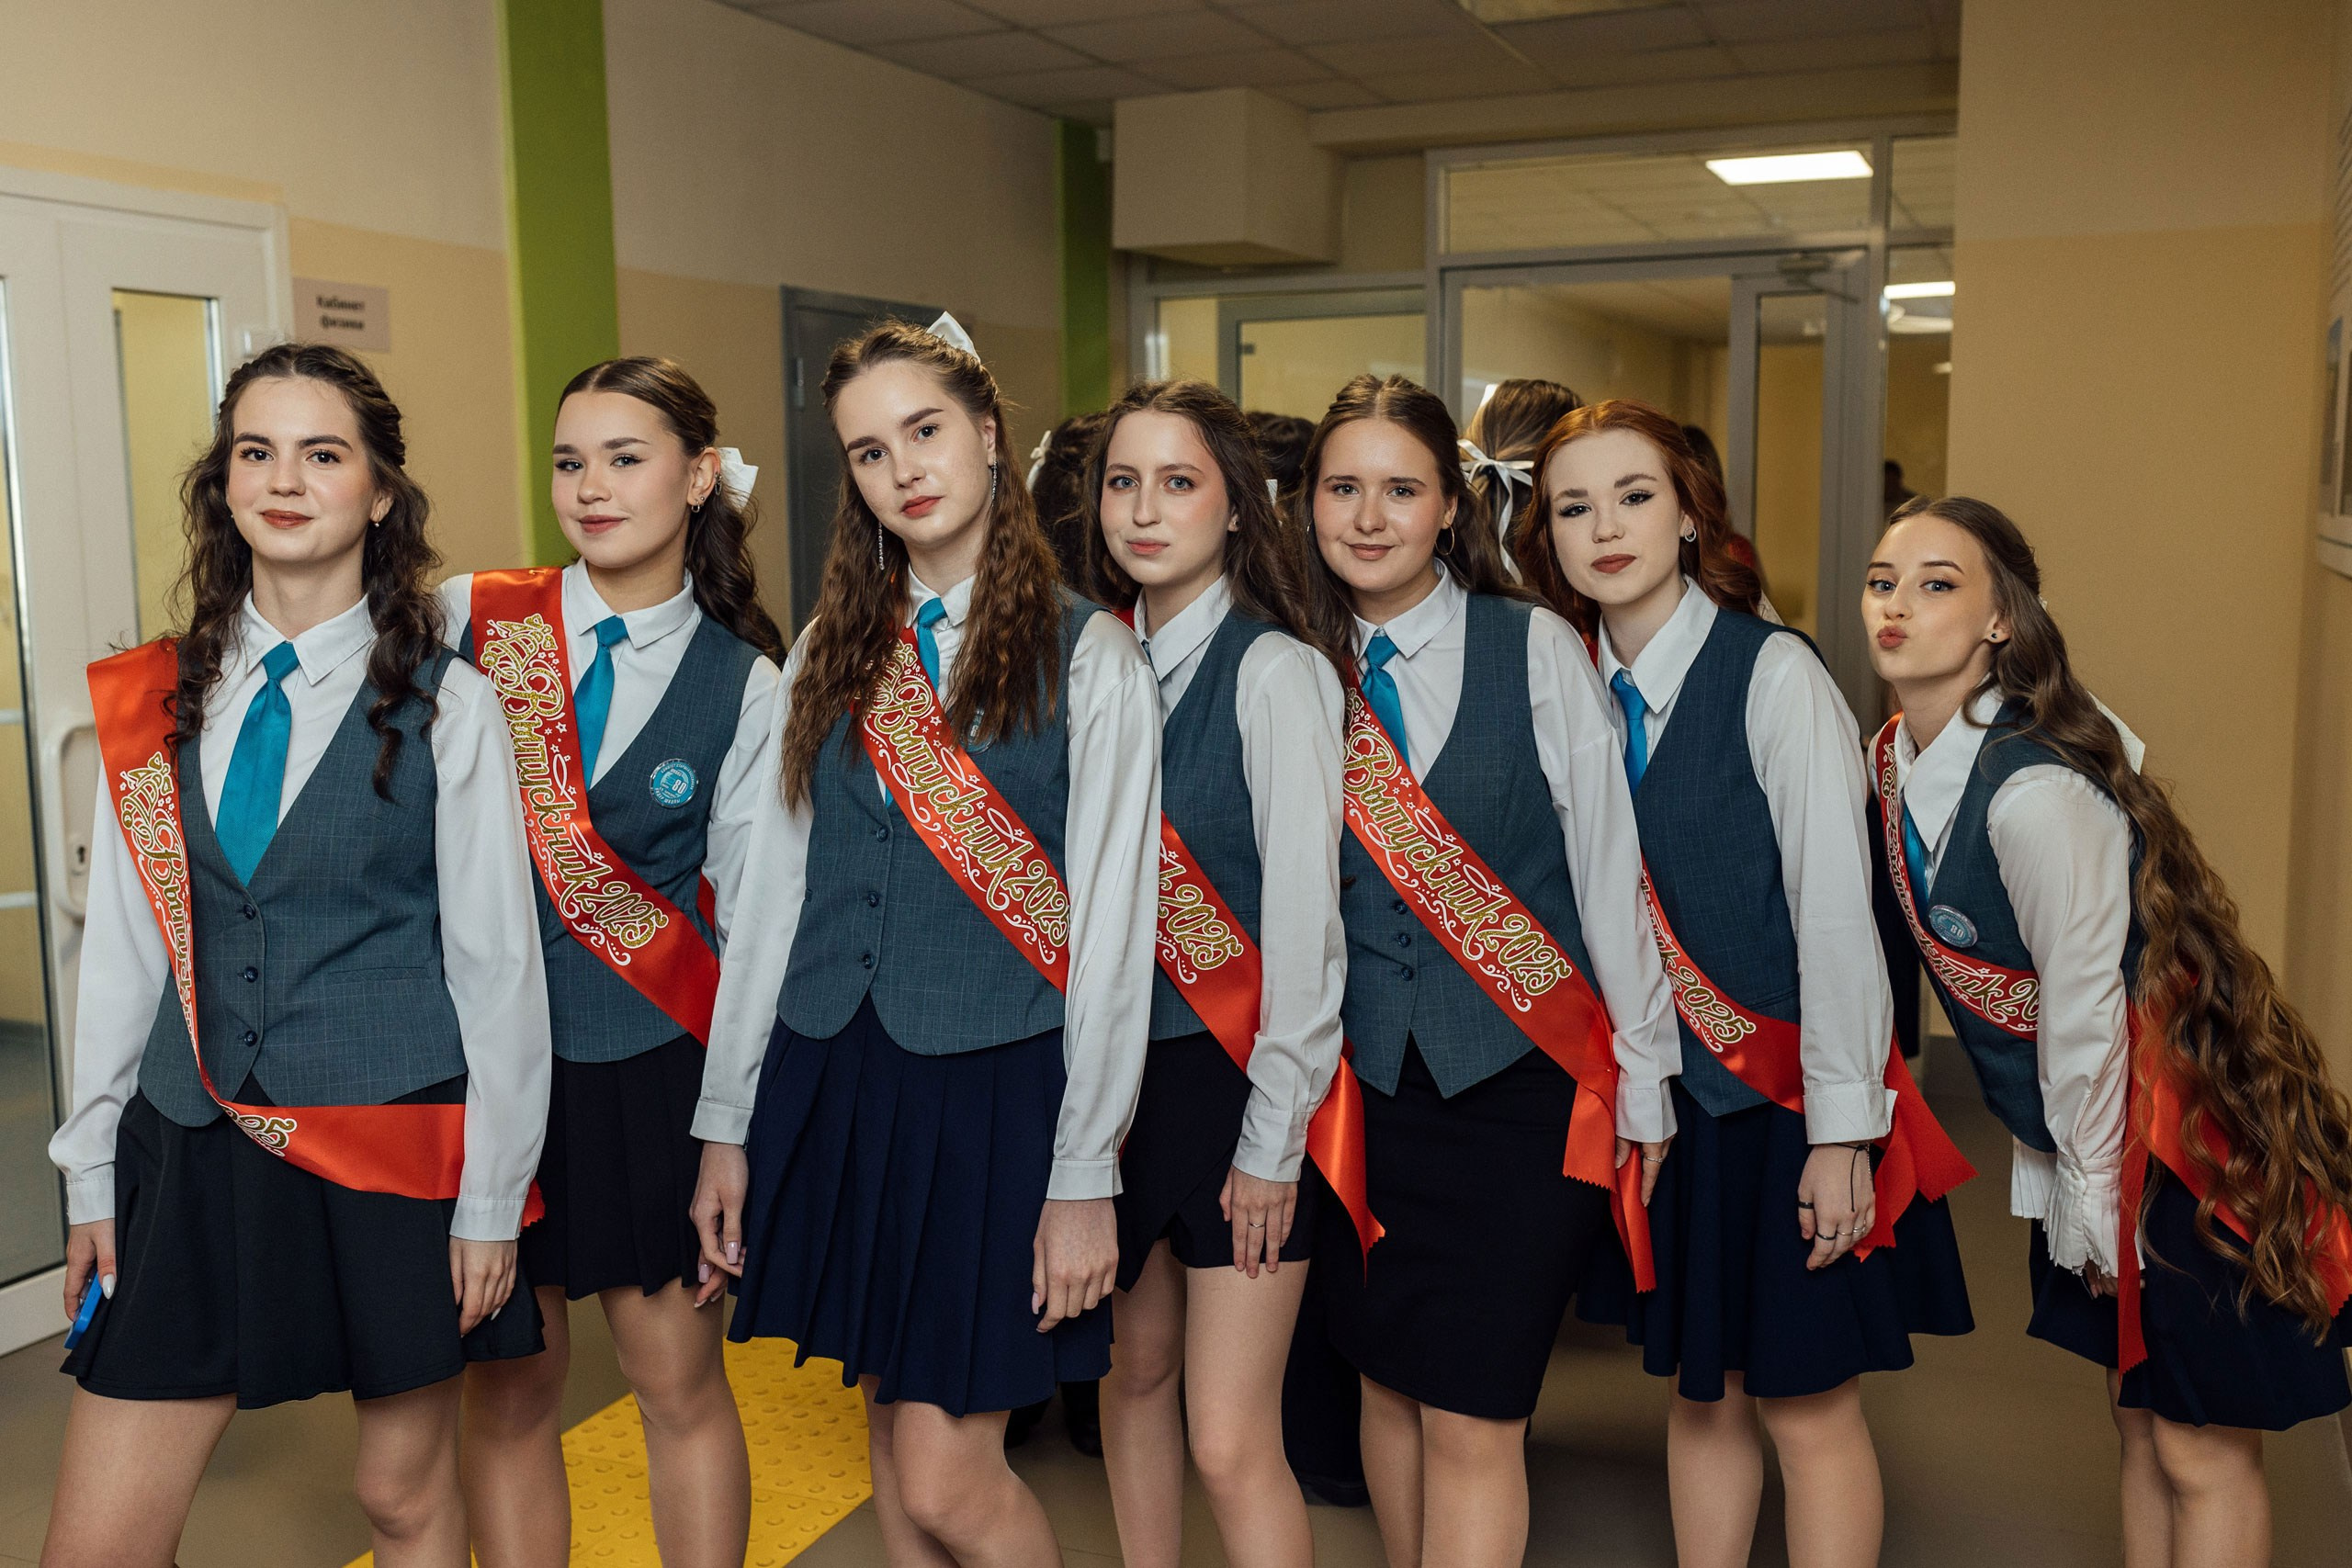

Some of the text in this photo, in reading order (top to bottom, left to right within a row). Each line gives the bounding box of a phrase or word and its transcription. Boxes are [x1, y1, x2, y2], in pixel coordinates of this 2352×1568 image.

[492, 663, 669, 949] Выпускник 2025
[672, 779, 687, 795] 80
[871, 678, 1034, 910] Выпускник
[1343, 728, 1572, 996] Выпускник 2025
[1158, 885, 1244, 971] 2025
[1668, 966, 1757, 1043] 2025
